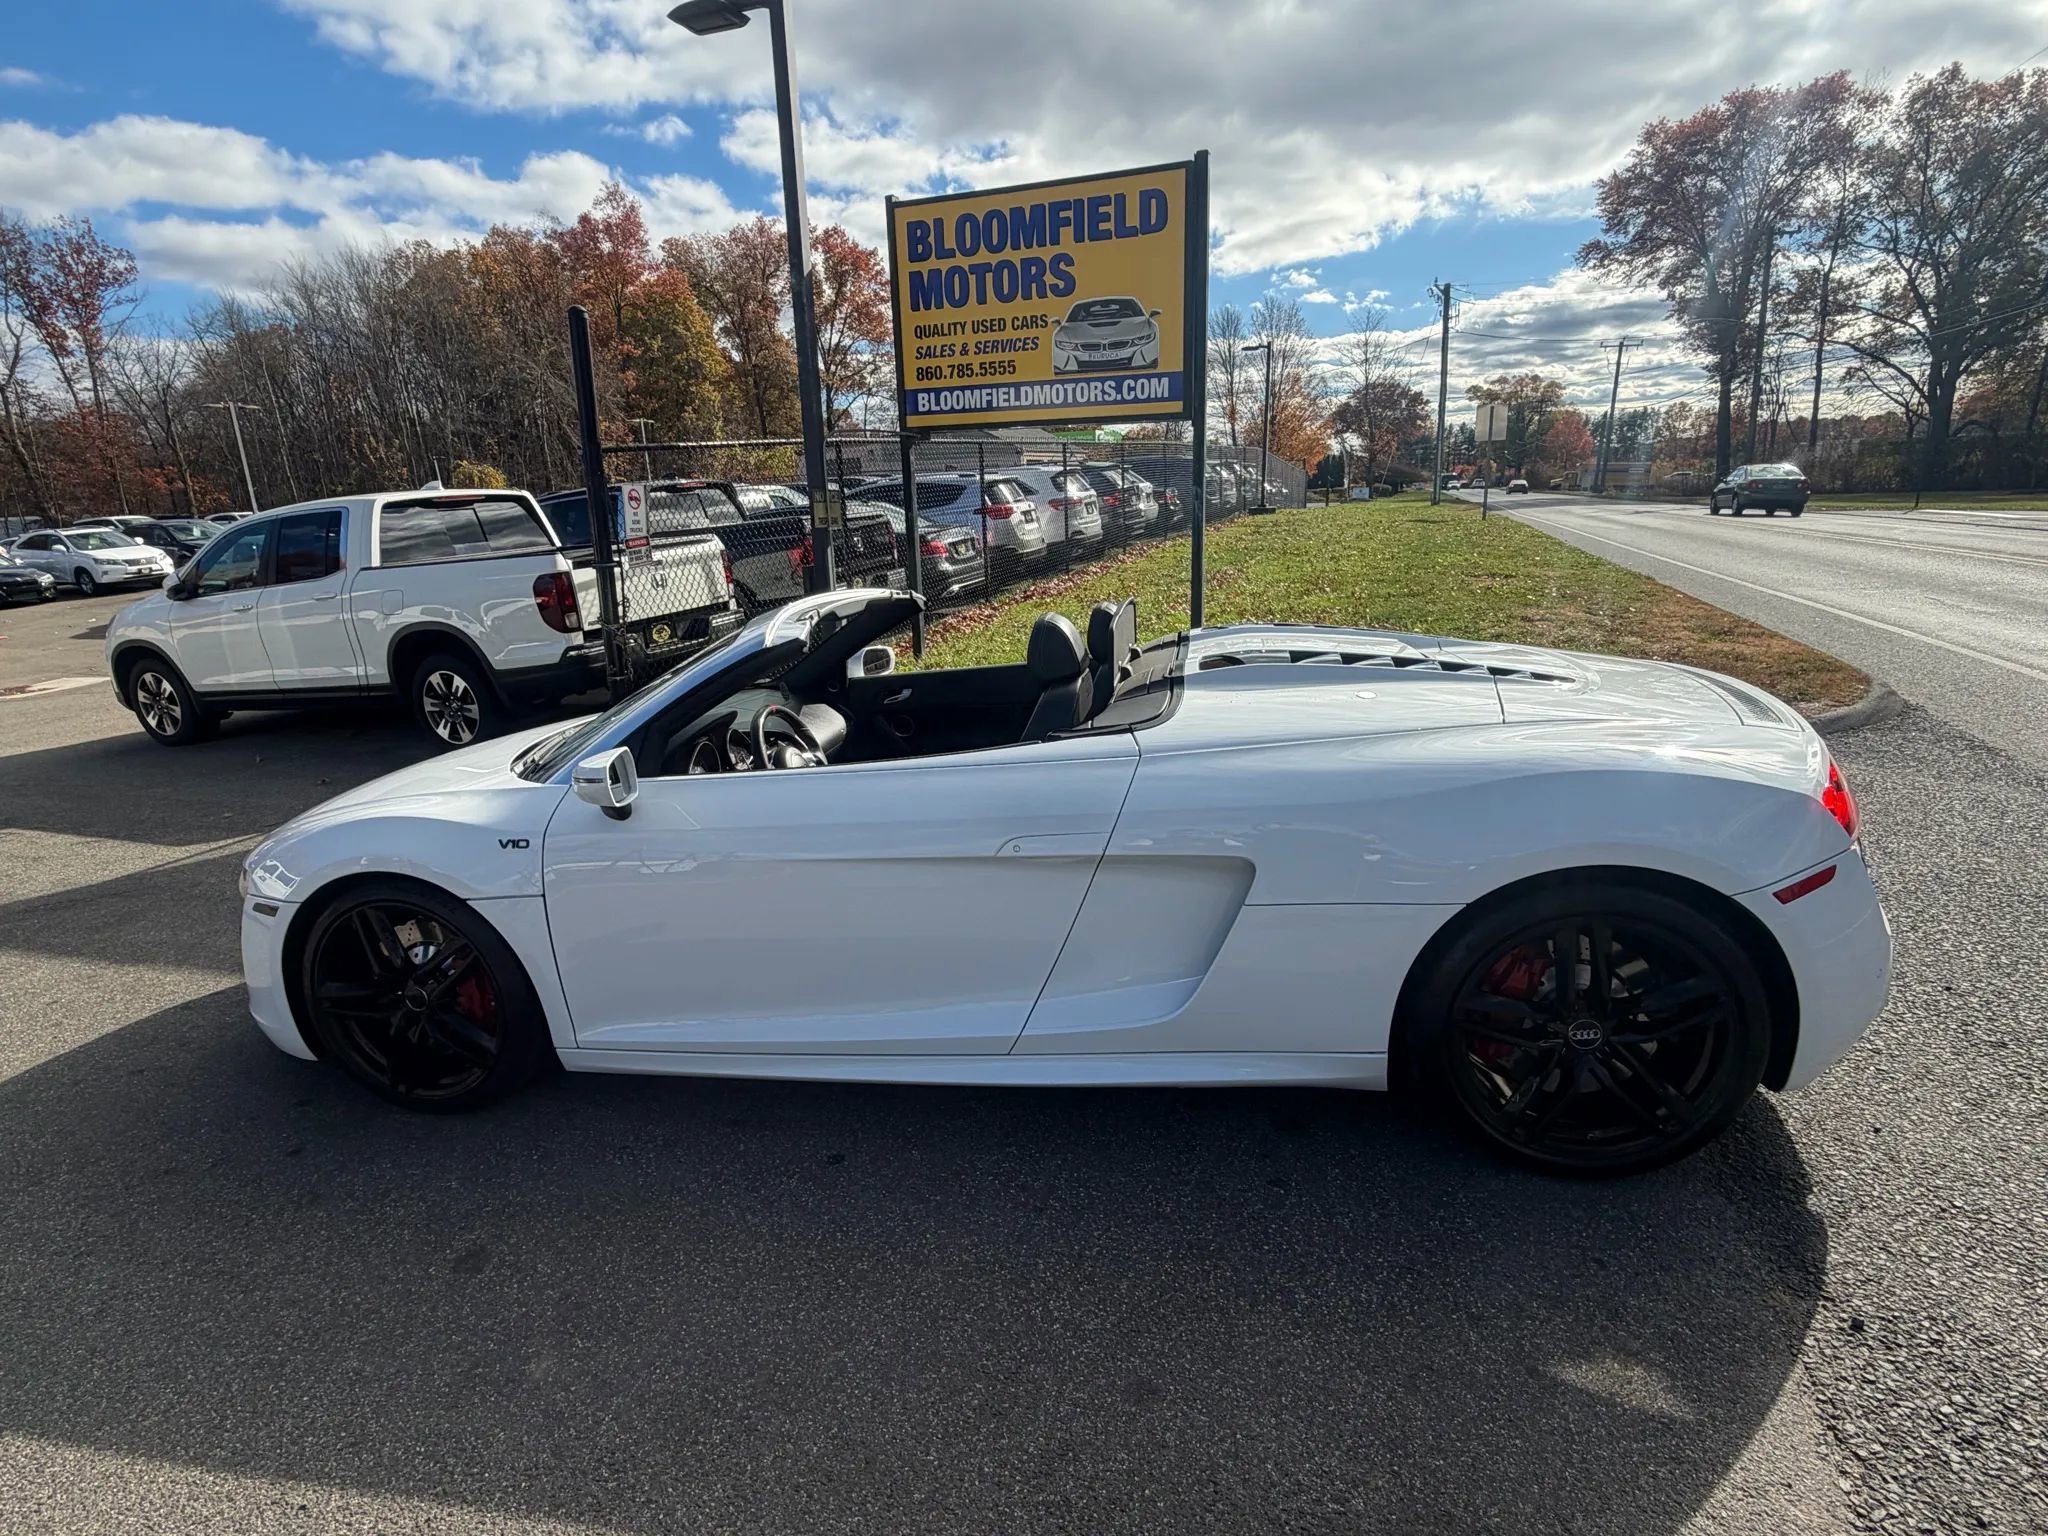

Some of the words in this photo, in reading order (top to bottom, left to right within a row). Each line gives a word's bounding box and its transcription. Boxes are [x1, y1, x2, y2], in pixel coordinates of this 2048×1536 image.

[906, 188, 1169, 263] BLOOMFIELD
[908, 252, 1077, 312] MOTORS
[914, 321, 967, 340] QUALITY
[972, 317, 1007, 334] USED
[1011, 313, 1049, 331] CARS
[915, 344, 957, 360] SALES
[959, 342, 969, 357] &
[974, 336, 1040, 356] SERVICES
[916, 359, 1017, 382] 860.785.5555
[917, 377, 1169, 412] BLOOMFIELDMOTORS.COM
[498, 838, 530, 850] V10
